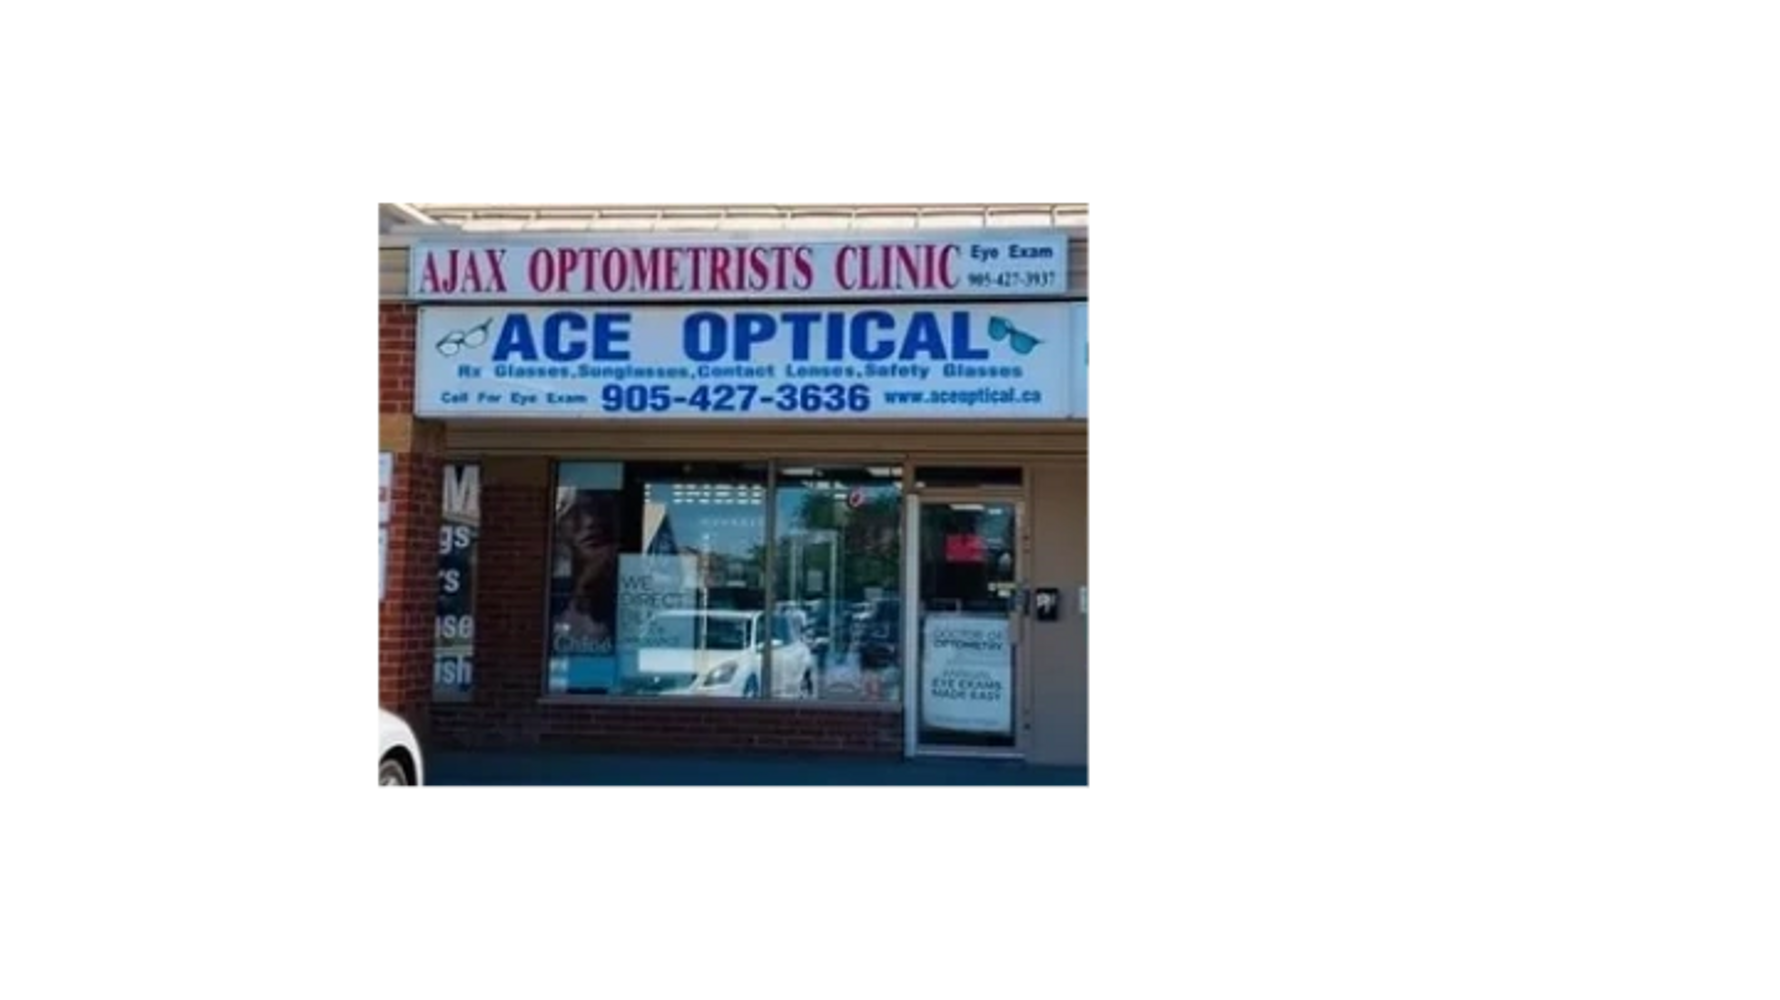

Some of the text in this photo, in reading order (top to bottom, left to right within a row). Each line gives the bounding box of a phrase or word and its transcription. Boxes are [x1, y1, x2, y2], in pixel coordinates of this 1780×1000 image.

[970, 244, 1053, 263] Eye Exam
[419, 243, 961, 293] AJAX OPTOMETRISTS CLINIC
[967, 270, 1055, 288] 905-427-3937
[492, 310, 989, 362] ACE OPTICAL
[458, 365, 481, 379] Rx
[943, 363, 1024, 378] Glasses
[441, 383, 1042, 412] Call For Eye Exam 905-427-3636 www.aceoptical.ca
